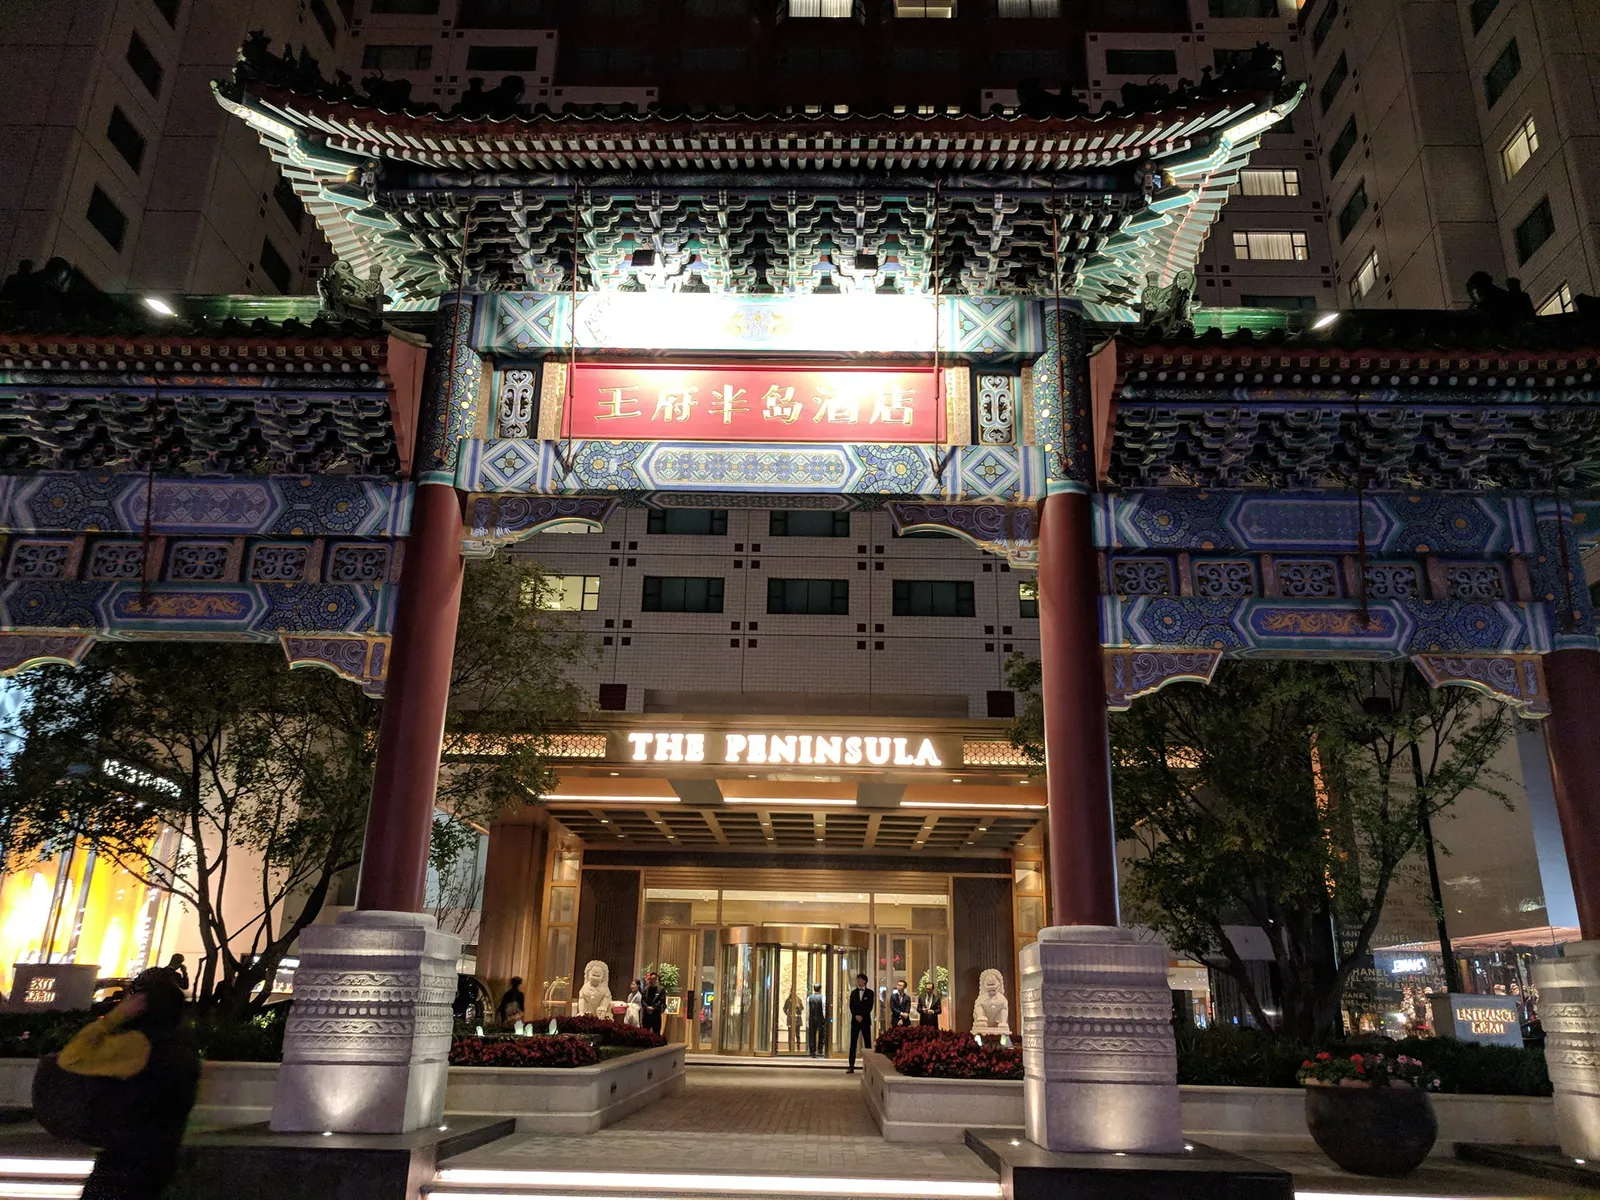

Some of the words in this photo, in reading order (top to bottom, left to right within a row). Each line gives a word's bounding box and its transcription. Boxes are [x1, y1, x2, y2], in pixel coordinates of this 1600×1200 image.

[594, 384, 917, 426] 王府半岛酒店
[628, 732, 706, 763] THE
[725, 734, 942, 767] PENINSULA
[1352, 967, 1389, 977] HANEL
[1456, 1008, 1517, 1022] ENTRANCE
